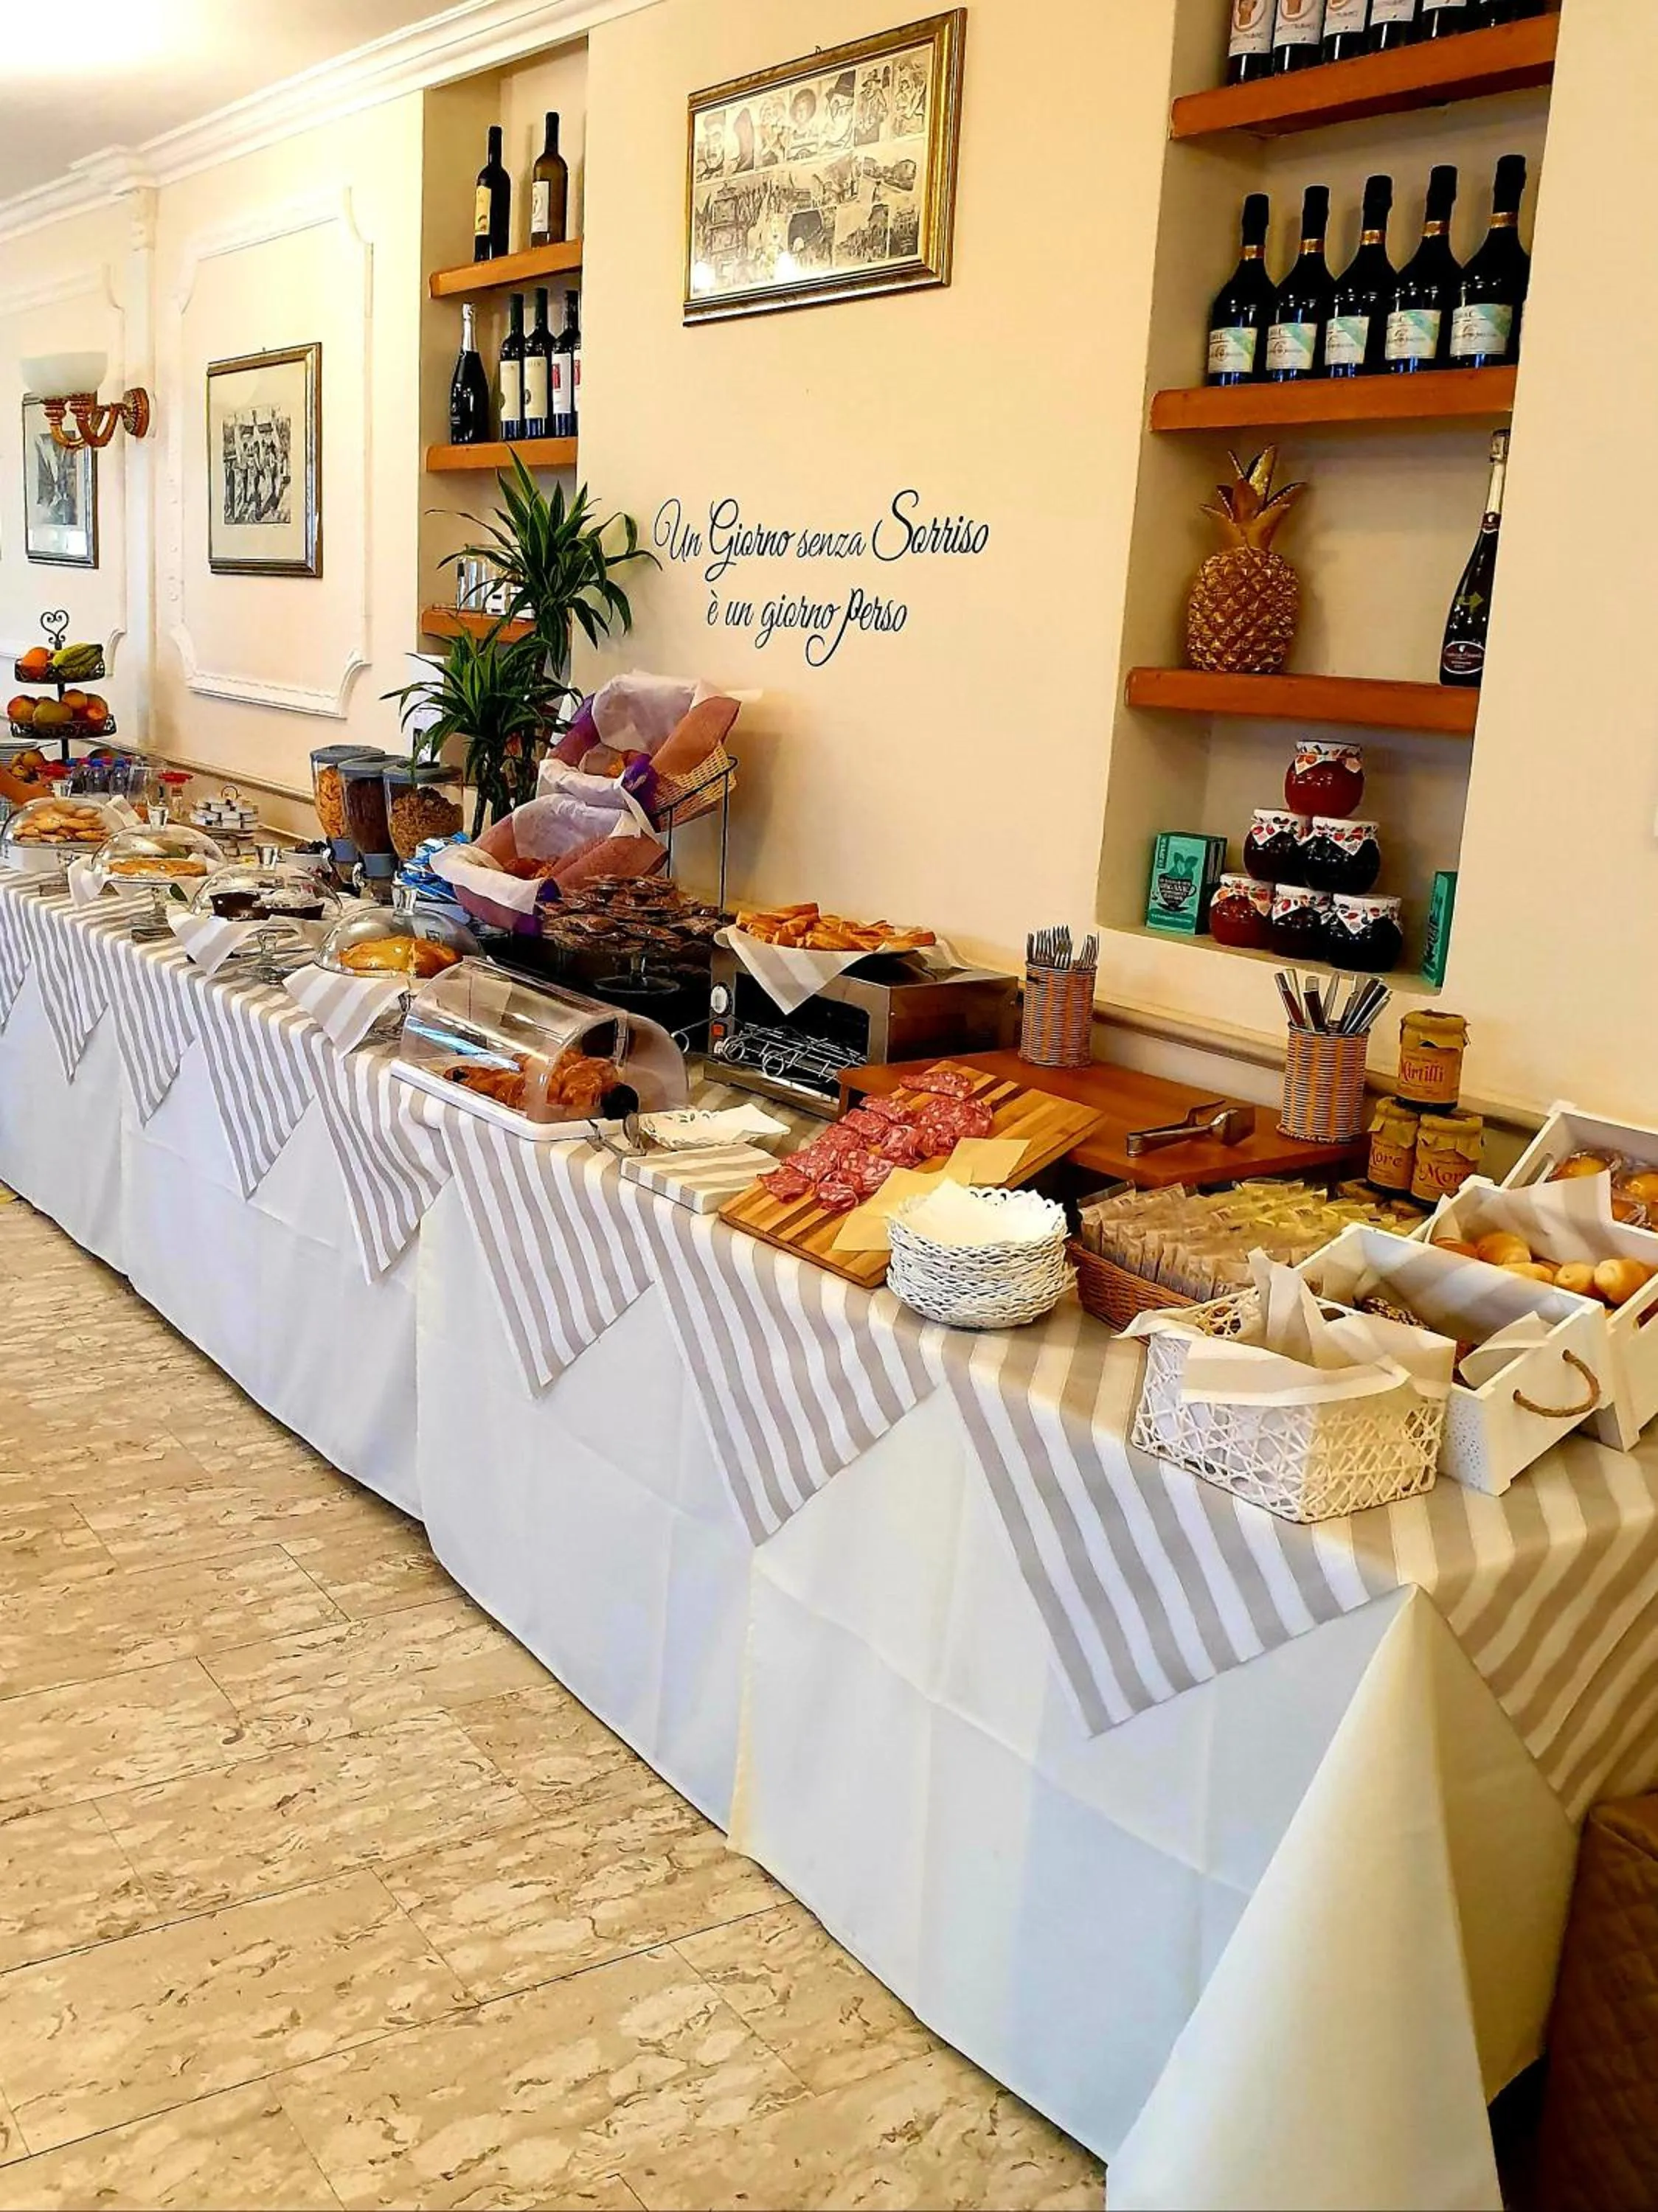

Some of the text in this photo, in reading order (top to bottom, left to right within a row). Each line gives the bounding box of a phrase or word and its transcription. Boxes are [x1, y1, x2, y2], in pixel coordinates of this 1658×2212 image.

[653, 490, 988, 582] Un Giorno senza Sorriso
[707, 590, 718, 626] è
[726, 601, 754, 626] un
[755, 594, 841, 649] giorno
[1418, 1163, 1463, 1186] Mor
